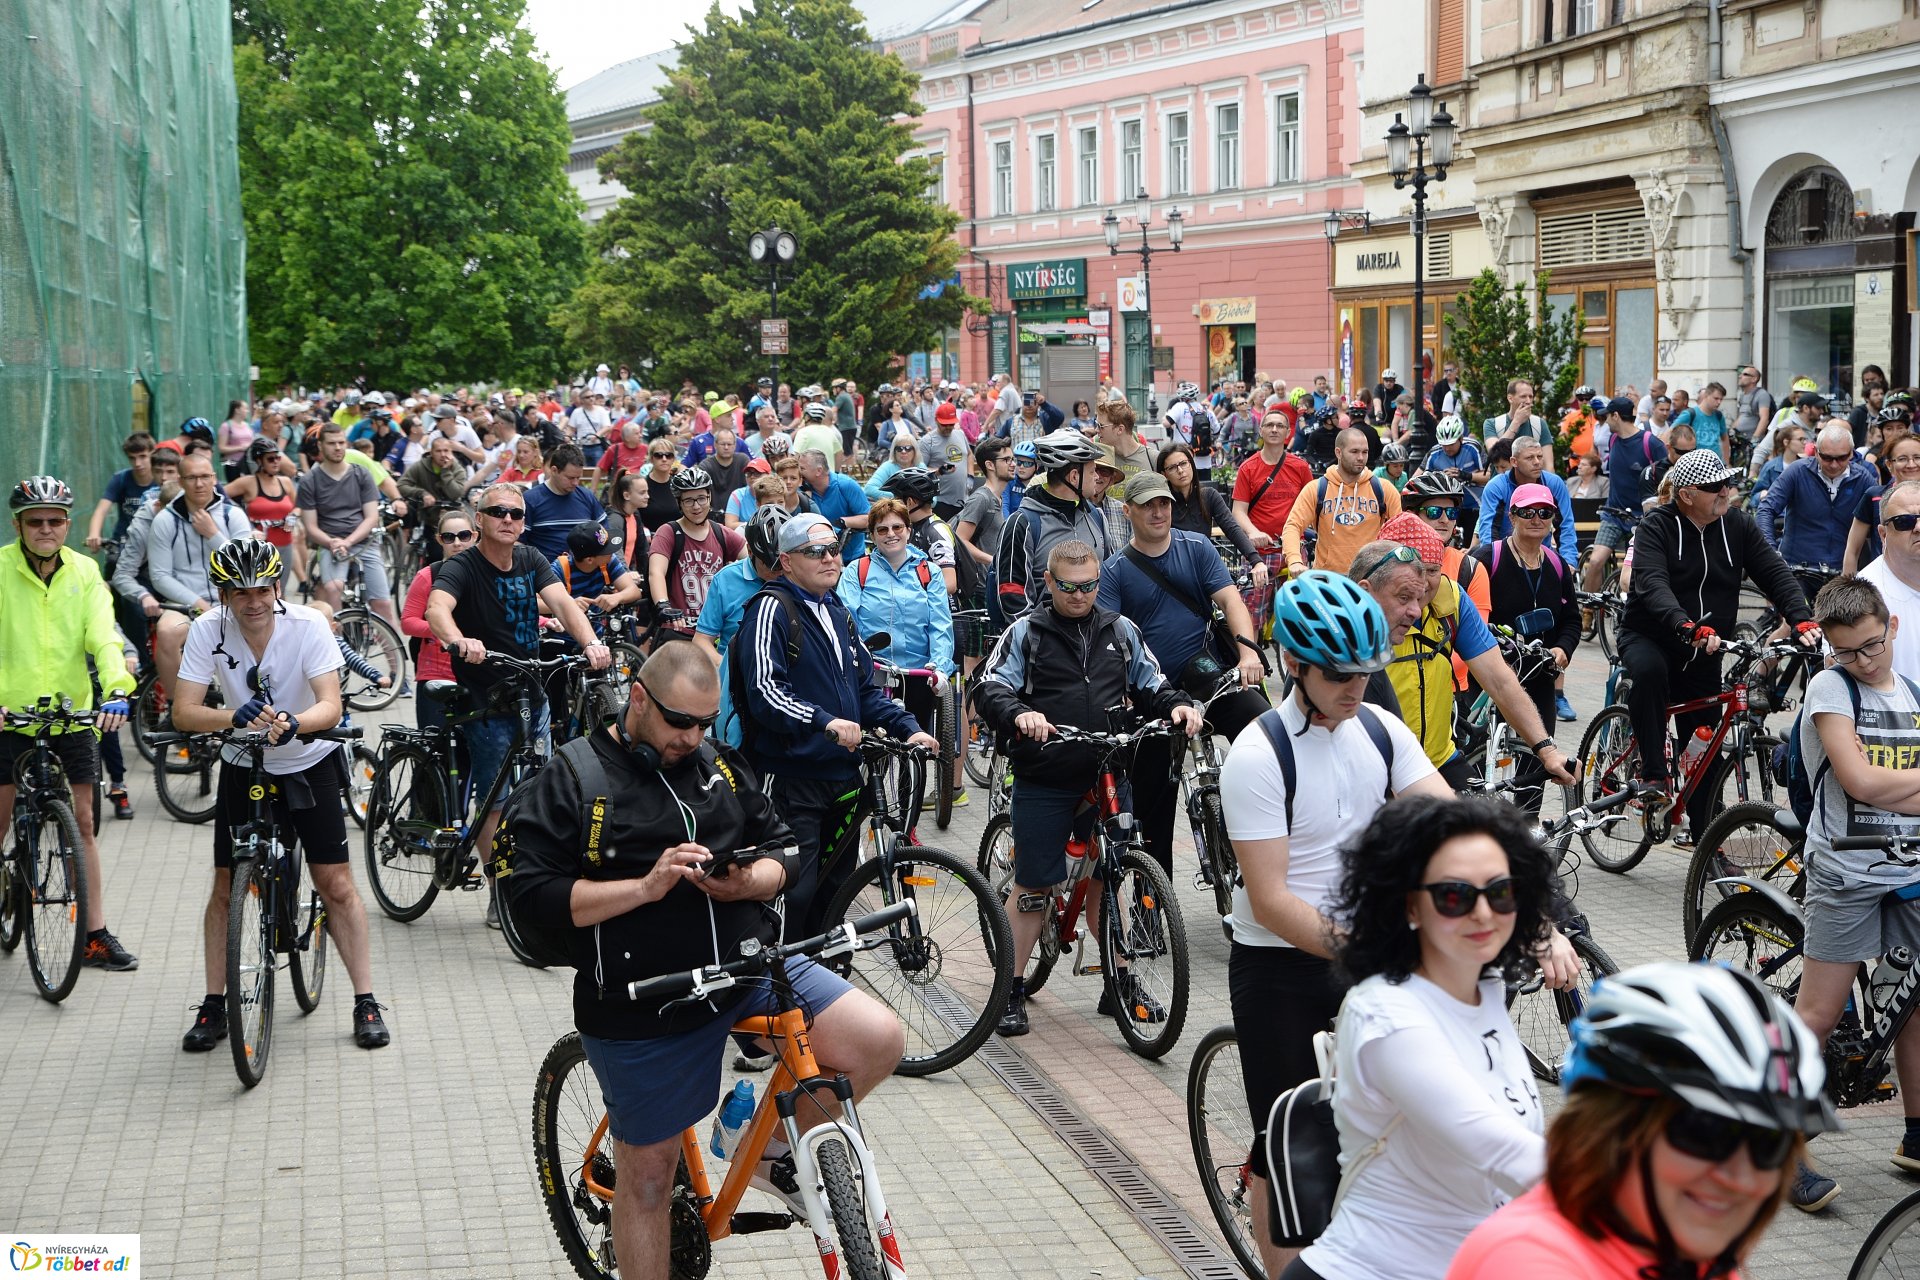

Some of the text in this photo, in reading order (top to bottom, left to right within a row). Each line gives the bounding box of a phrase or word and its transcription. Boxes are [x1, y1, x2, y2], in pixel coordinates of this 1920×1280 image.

[1356, 251, 1401, 271] MARELLA
[1014, 263, 1076, 289] NYÍRSÉG
[1052, 287, 1076, 296] IRODA
[538, 1098, 555, 1196] GEAX NEURON
